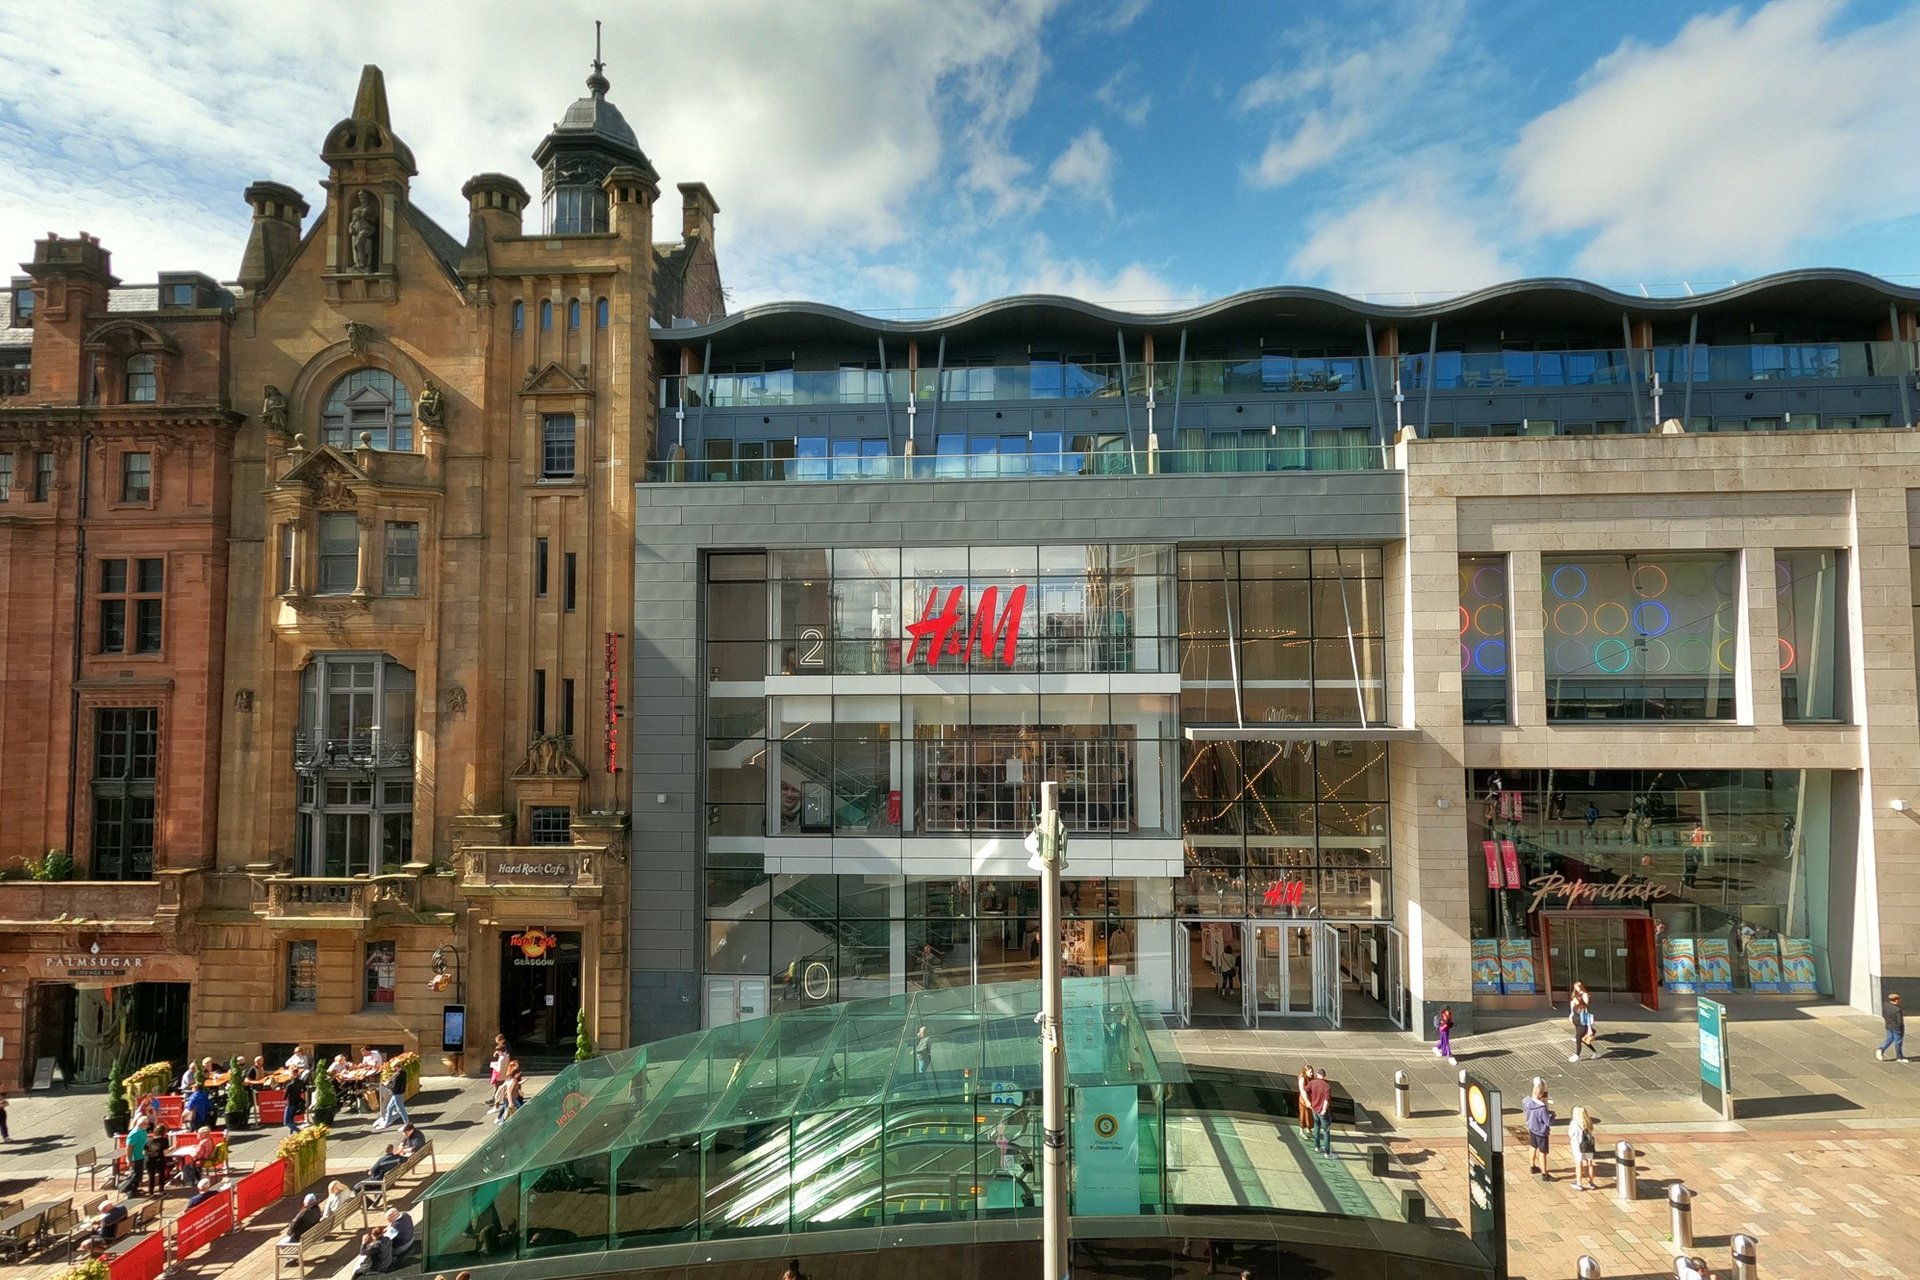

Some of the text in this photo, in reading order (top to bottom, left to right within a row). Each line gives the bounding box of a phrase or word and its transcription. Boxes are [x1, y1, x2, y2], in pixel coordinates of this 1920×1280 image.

[905, 584, 1027, 668] H&M
[800, 628, 824, 665] 2
[498, 863, 566, 876] Hard Rock Cafe
[1527, 870, 1673, 914] Paperchase
[46, 957, 143, 967] PALMSUGAR
[513, 958, 555, 966] GLASGOW
